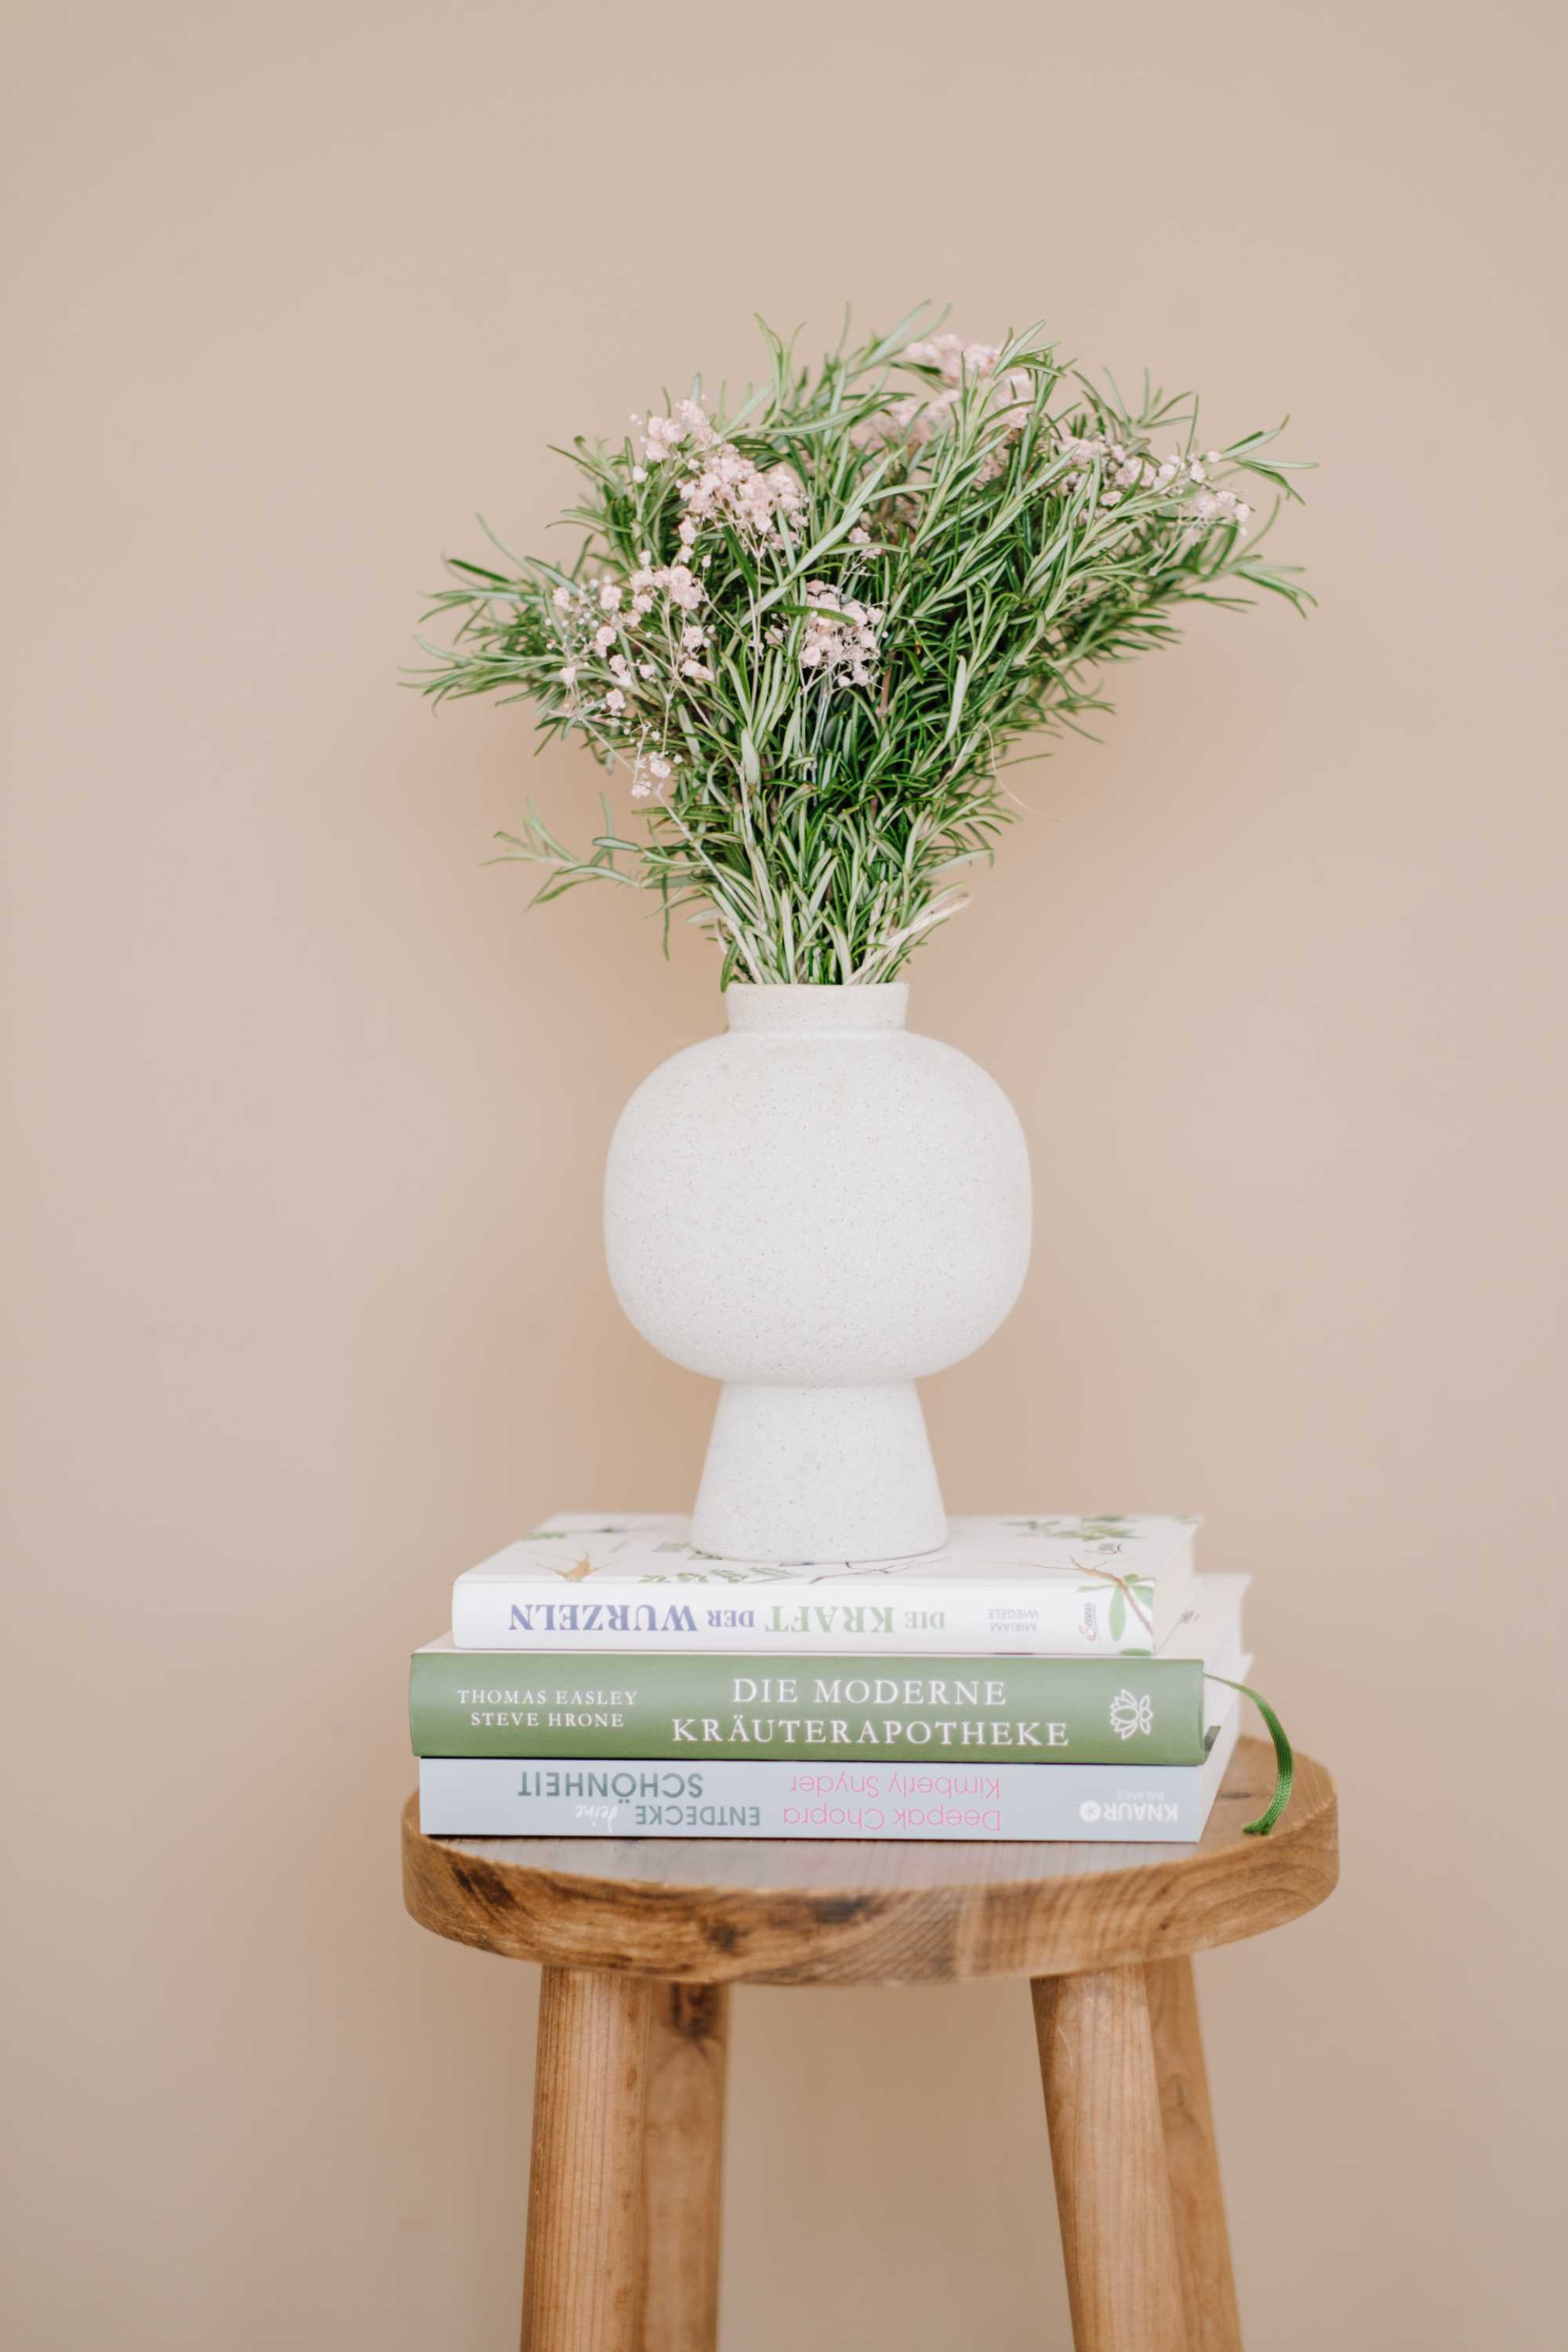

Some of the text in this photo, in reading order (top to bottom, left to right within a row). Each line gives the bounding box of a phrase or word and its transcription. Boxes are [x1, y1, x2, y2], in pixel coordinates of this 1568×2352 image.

[508, 1604, 946, 1633] DIE KRAFT DER WURZELN
[988, 1609, 1040, 1620] WIEGELE
[989, 1622, 1037, 1632] MIRIAM
[457, 1690, 637, 1706] THOMAS EASLEY
[732, 1678, 1007, 1705] DIE MODERNE
[470, 1712, 623, 1728] STEVE HRONE
[672, 1715, 1069, 1747] KRÄUTERAPOTHEKE
[517, 1771, 704, 1804] SCHÖNHEIT
[789, 1769, 1000, 1799] Kimberly Snyder
[575, 1804, 760, 1833] ENTDECKE deine
[782, 1802, 1001, 1831] Deepak Chopra
[1103, 1802, 1179, 1821] KNAUR
